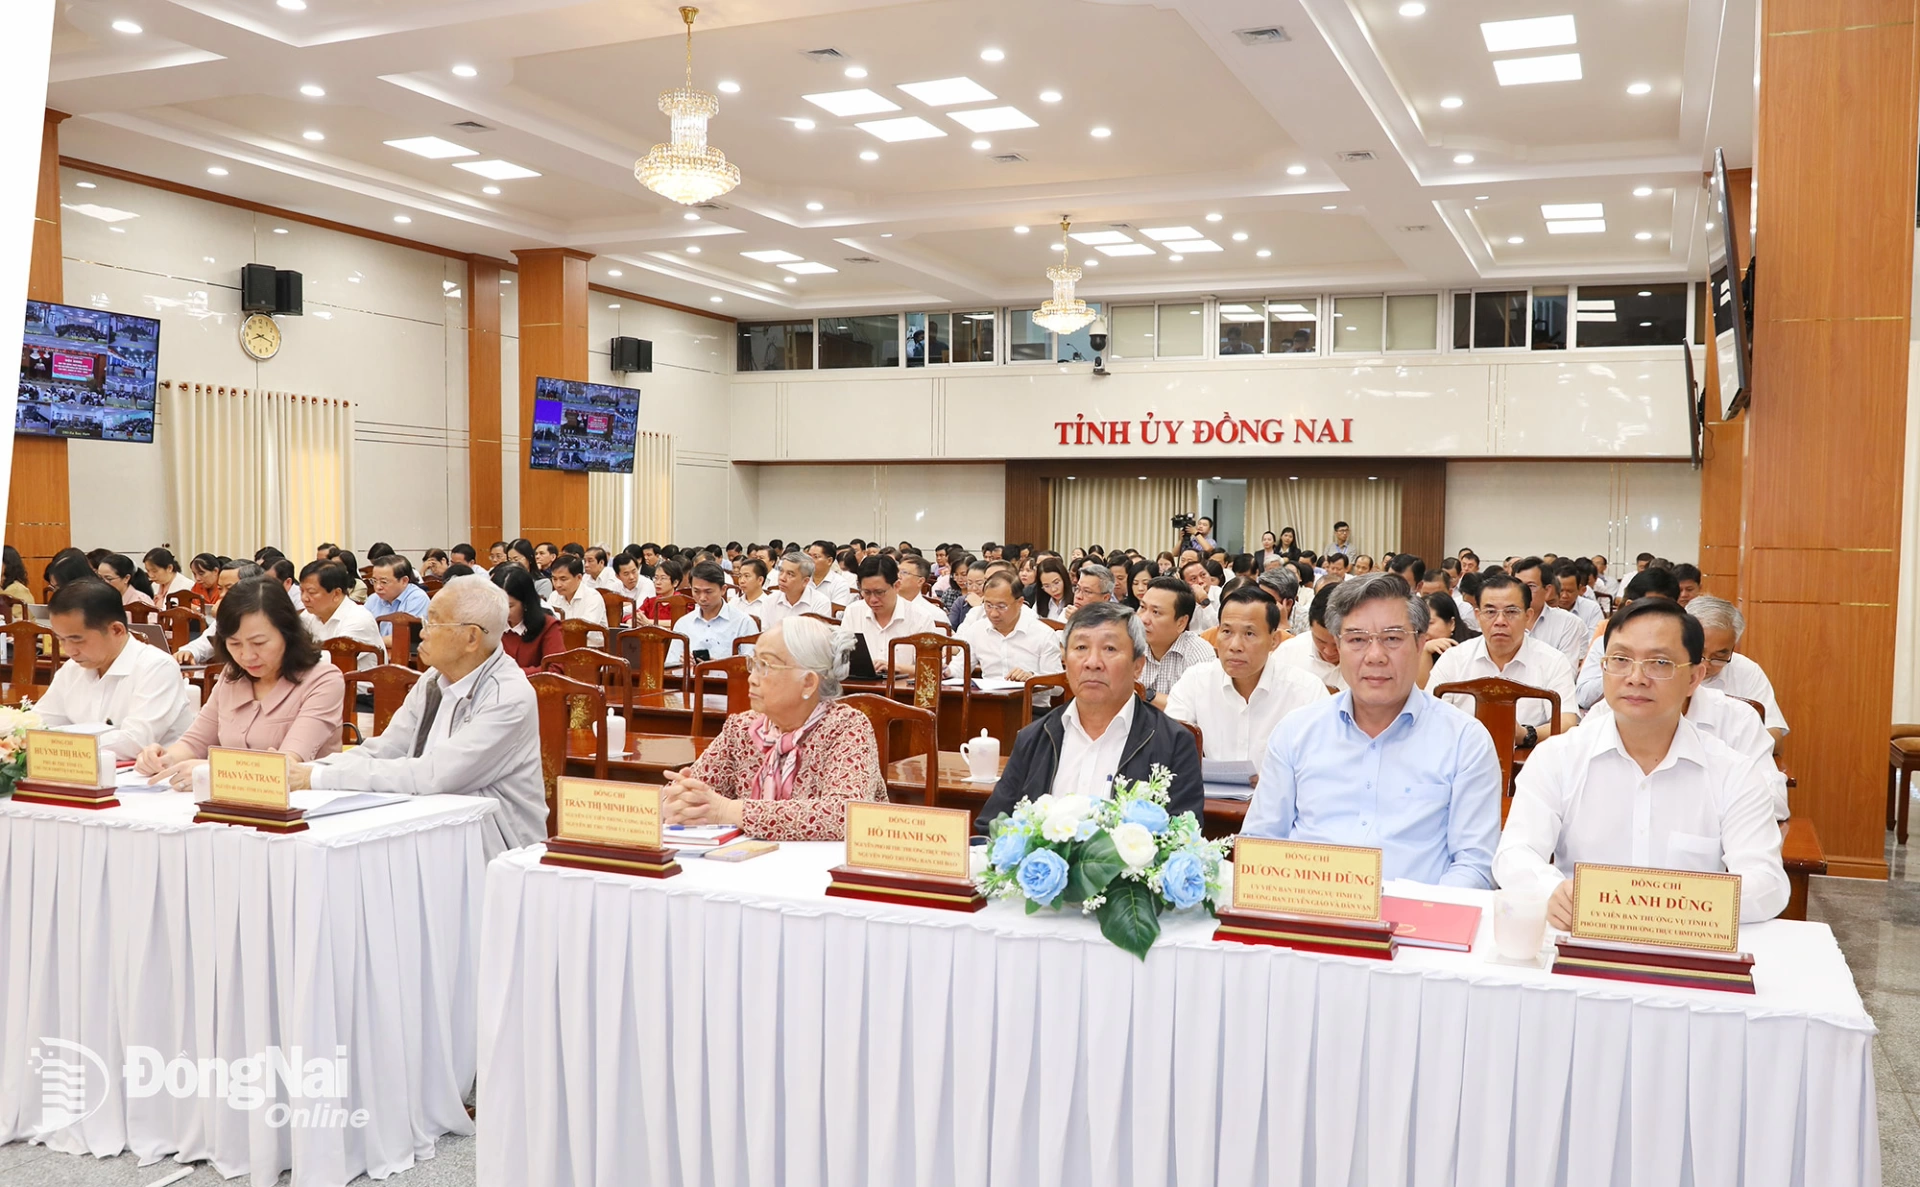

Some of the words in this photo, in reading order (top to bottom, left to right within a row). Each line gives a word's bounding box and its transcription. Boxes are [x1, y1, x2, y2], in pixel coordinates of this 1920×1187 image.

[1054, 413, 1131, 445] TỈNH
[1140, 412, 1184, 444] ỦY
[1192, 411, 1284, 444] ĐỒNG
[1293, 418, 1354, 443] NAI
[217, 769, 237, 779] PHAN
[237, 770, 254, 781] VĂN
[255, 773, 281, 785] TRANG
[587, 800, 602, 812] THỊ
[602, 802, 625, 813] MINH
[888, 815, 910, 825] ĐỒNG
[911, 818, 926, 827] CHÍ
[886, 828, 924, 842] THANH
[925, 832, 948, 844] SƠN
[1285, 851, 1311, 862] ĐỒNG
[1312, 854, 1330, 863] CHÍ
[1241, 863, 1290, 879] DƯƠNG
[1294, 868, 1331, 883] MINH
[1335, 871, 1375, 887] DŨNG
[1278, 886, 1292, 894] BAN
[1631, 878, 1661, 889] ĐỒNG
[1662, 881, 1682, 891] CHÍ
[1599, 889, 1622, 905] HÀ
[1626, 894, 1661, 909] ANH
[1665, 895, 1714, 913] DŨNG
[1602, 911, 1621, 919] VIÊN
[1675, 918, 1686, 927] VỤ
[1610, 923, 1625, 931] TỊCH
[1656, 927, 1674, 936] TRỰC
